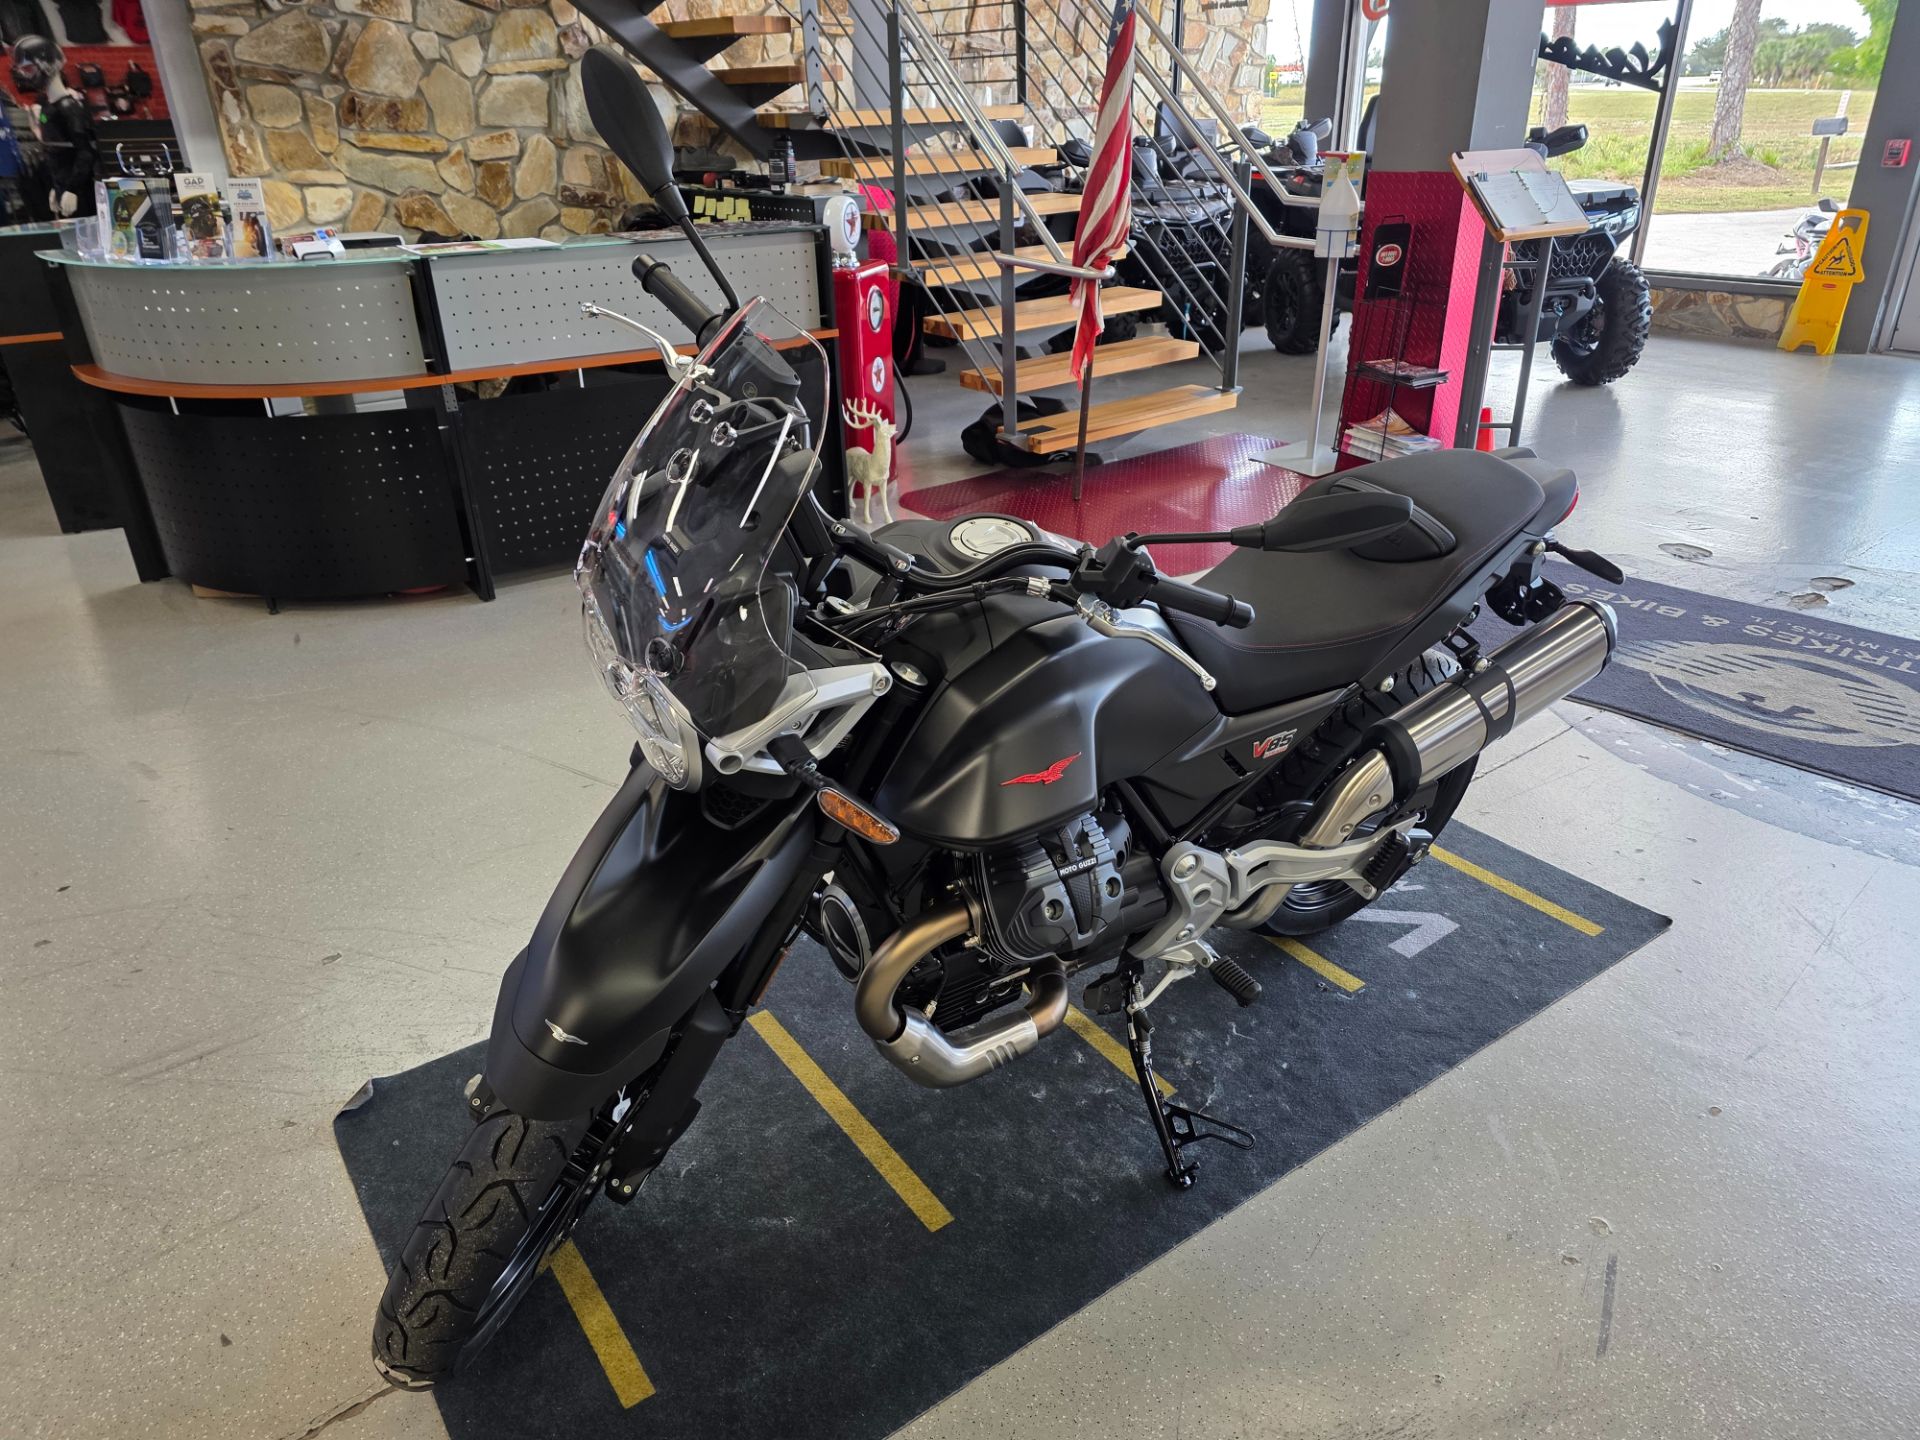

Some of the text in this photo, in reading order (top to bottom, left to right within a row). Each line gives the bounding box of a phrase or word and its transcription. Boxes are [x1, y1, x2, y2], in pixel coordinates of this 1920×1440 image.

[1562, 583, 1918, 674] TRIKES & BIKES
[1750, 615, 1778, 626] FL
[1253, 732, 1294, 758] V85
[1059, 857, 1097, 876] MOTO GUZZI
